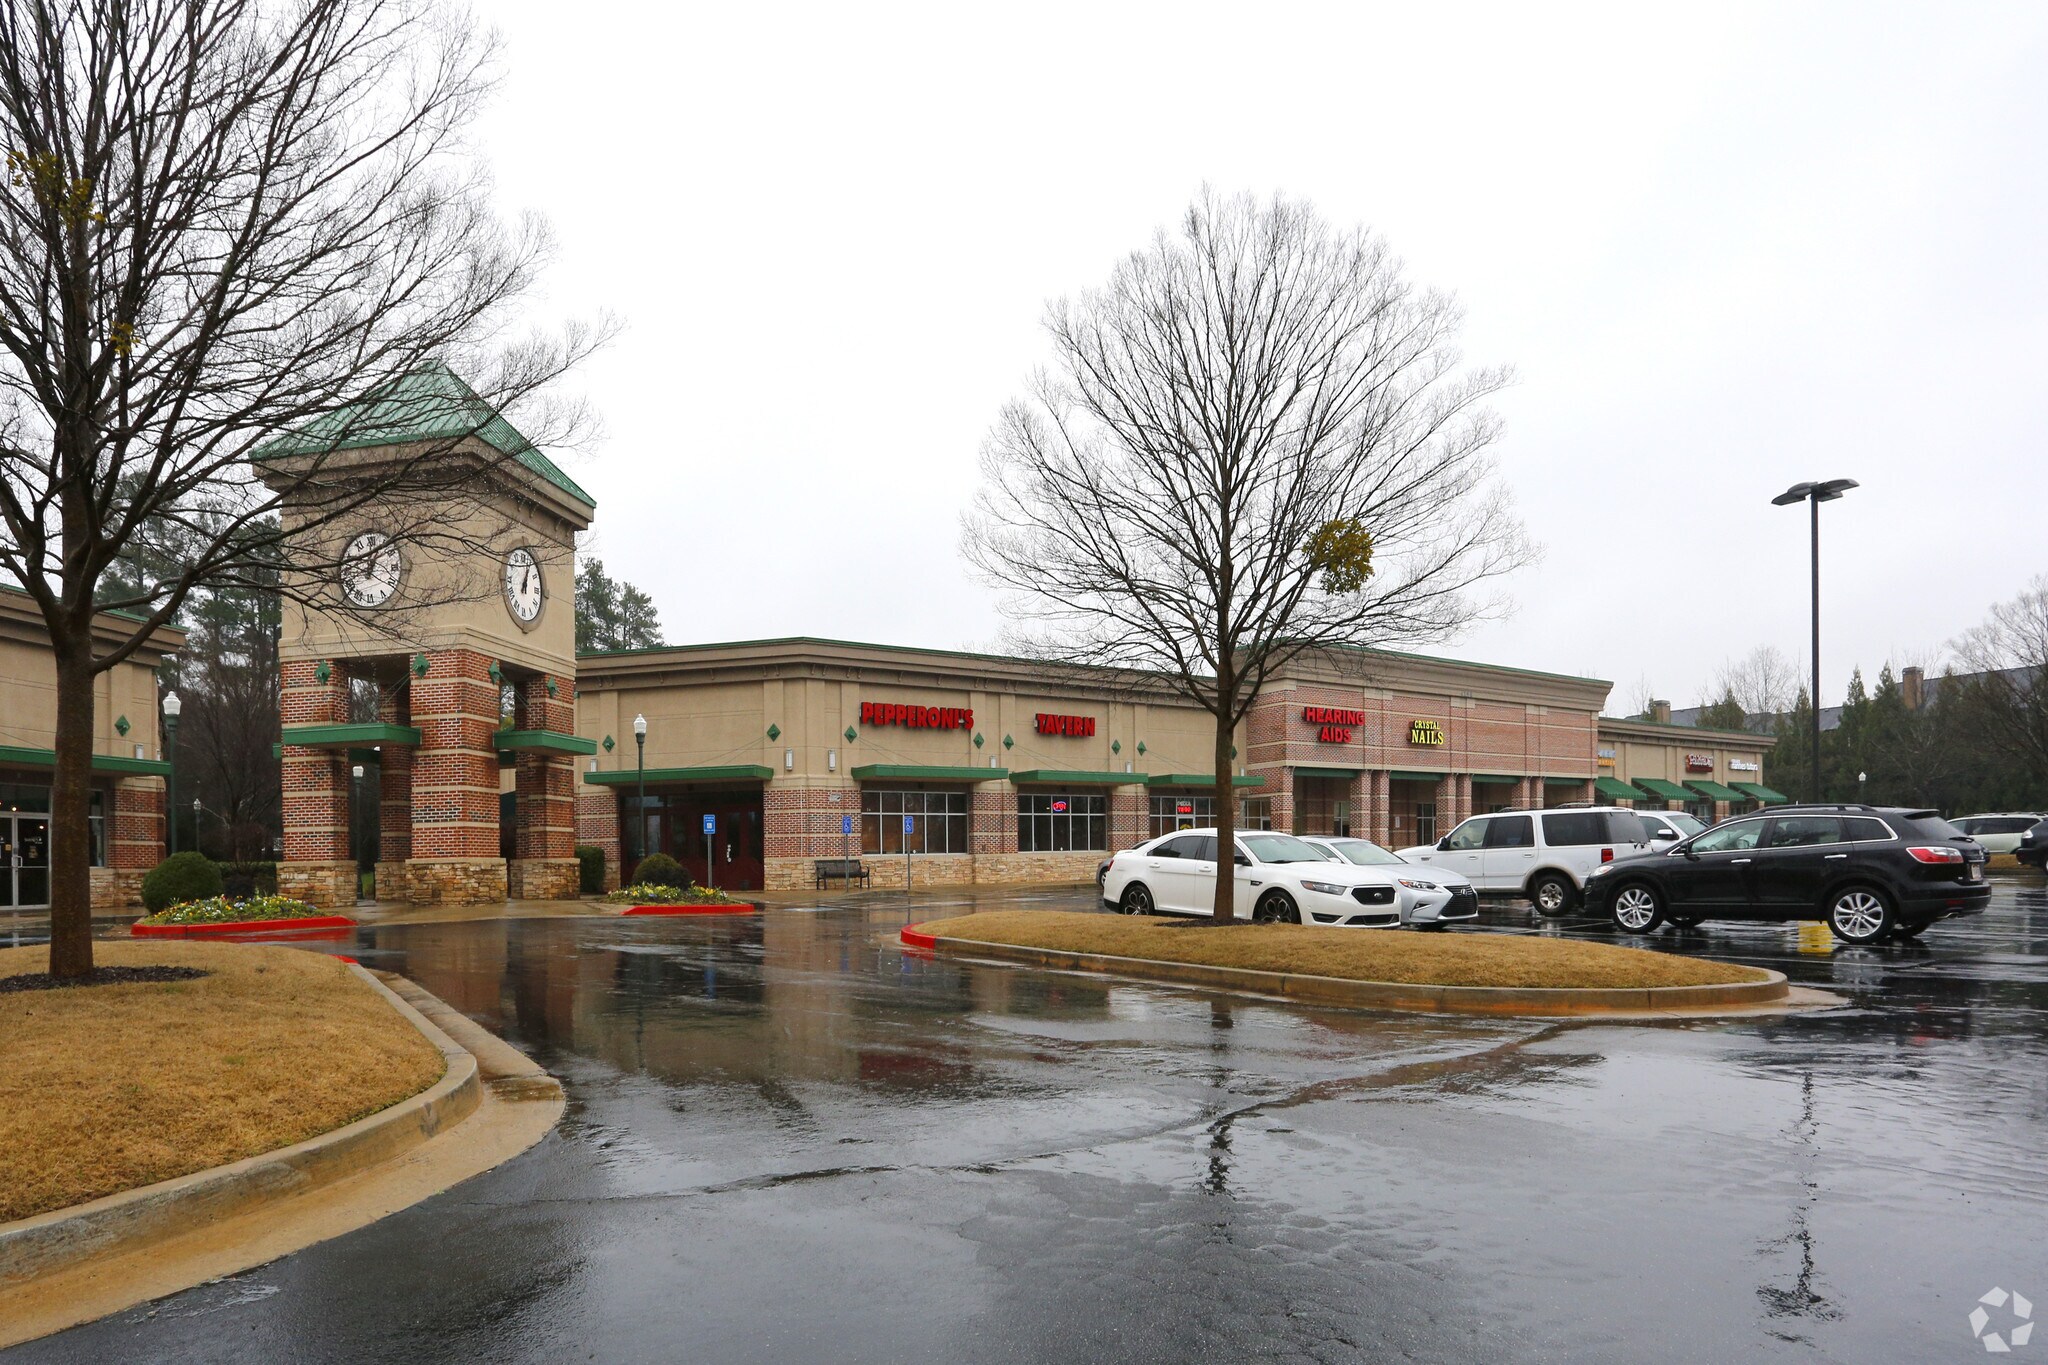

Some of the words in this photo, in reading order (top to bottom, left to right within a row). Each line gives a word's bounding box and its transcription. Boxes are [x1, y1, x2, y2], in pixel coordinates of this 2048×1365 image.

[861, 702, 974, 730] PEPPERONI'S
[1036, 713, 1095, 737] TAVERN
[1304, 706, 1365, 726] HEARING
[1414, 720, 1440, 730] CRYSTAL
[1320, 725, 1352, 744] AIDS
[1411, 729, 1444, 745] NAILS
